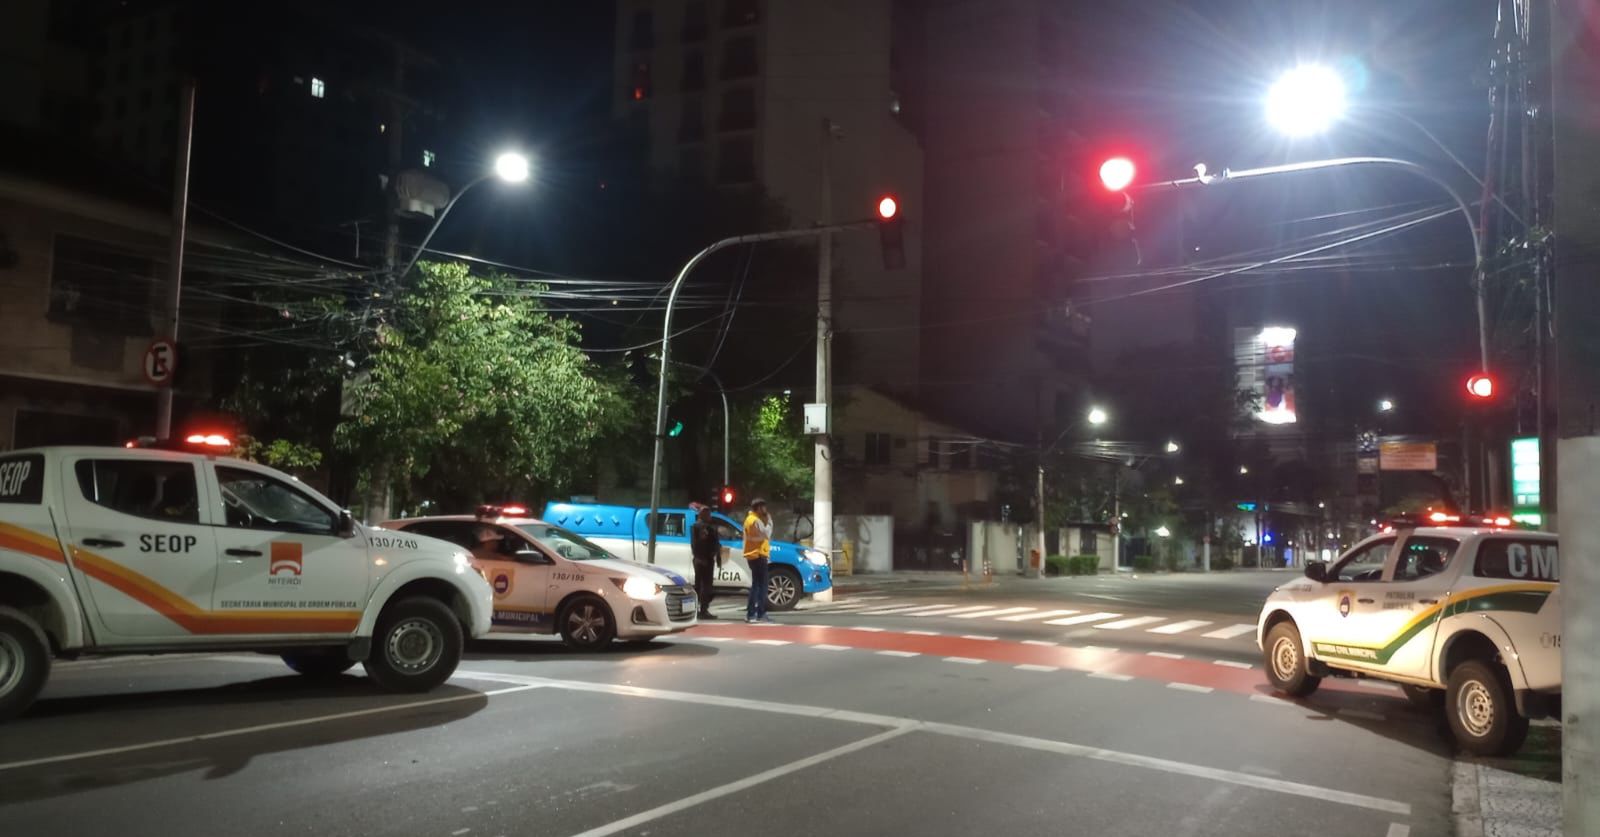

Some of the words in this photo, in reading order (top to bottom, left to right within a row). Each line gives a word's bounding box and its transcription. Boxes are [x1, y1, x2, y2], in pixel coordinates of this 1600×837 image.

[0, 461, 31, 496] SEOP
[139, 534, 197, 553] SEOP
[369, 536, 418, 550] 130/240
[220, 600, 261, 608] SECRETARIA
[262, 600, 297, 608] MUNICIPAL
[298, 600, 307, 608] DE
